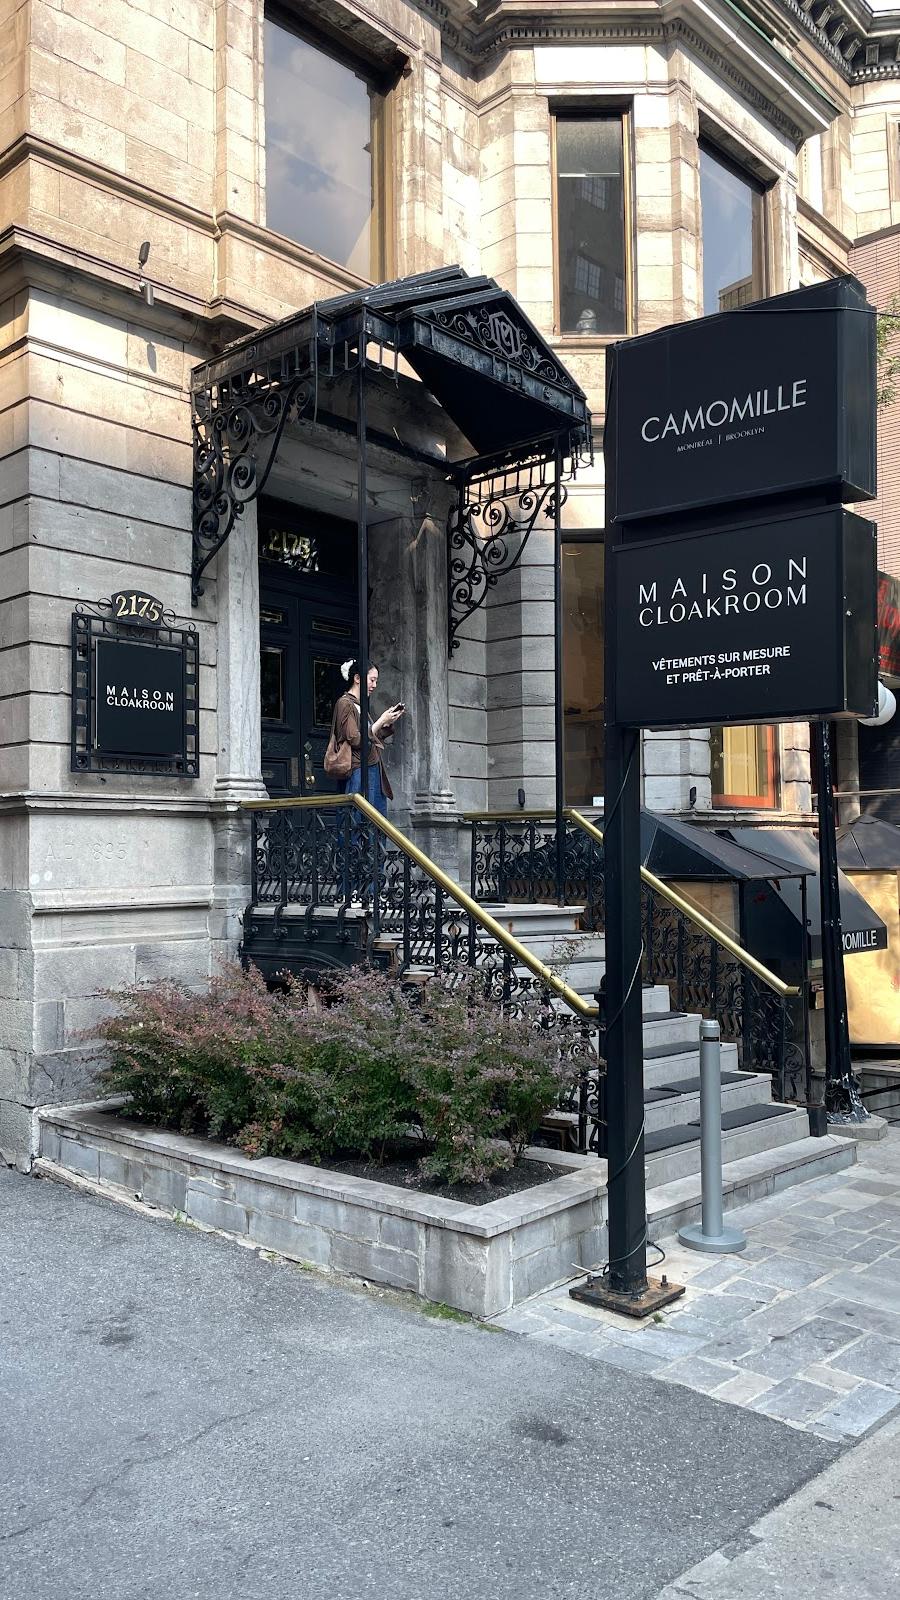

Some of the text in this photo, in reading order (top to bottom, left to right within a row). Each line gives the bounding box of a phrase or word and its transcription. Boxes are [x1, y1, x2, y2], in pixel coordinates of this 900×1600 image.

[641, 379, 807, 443] CAMOMILLE
[725, 426, 765, 441] BROOKLYN
[639, 556, 807, 604] MAISON
[116, 595, 162, 622] 2175
[639, 584, 807, 627] CLOAKROOM
[652, 646, 791, 671] VÊTEMENTS SUR MESURE
[666, 665, 771, 685] ET PRÊT-À-PORTER
[106, 685, 174, 702] MAISON
[106, 696, 174, 712] CLOAKROOM
